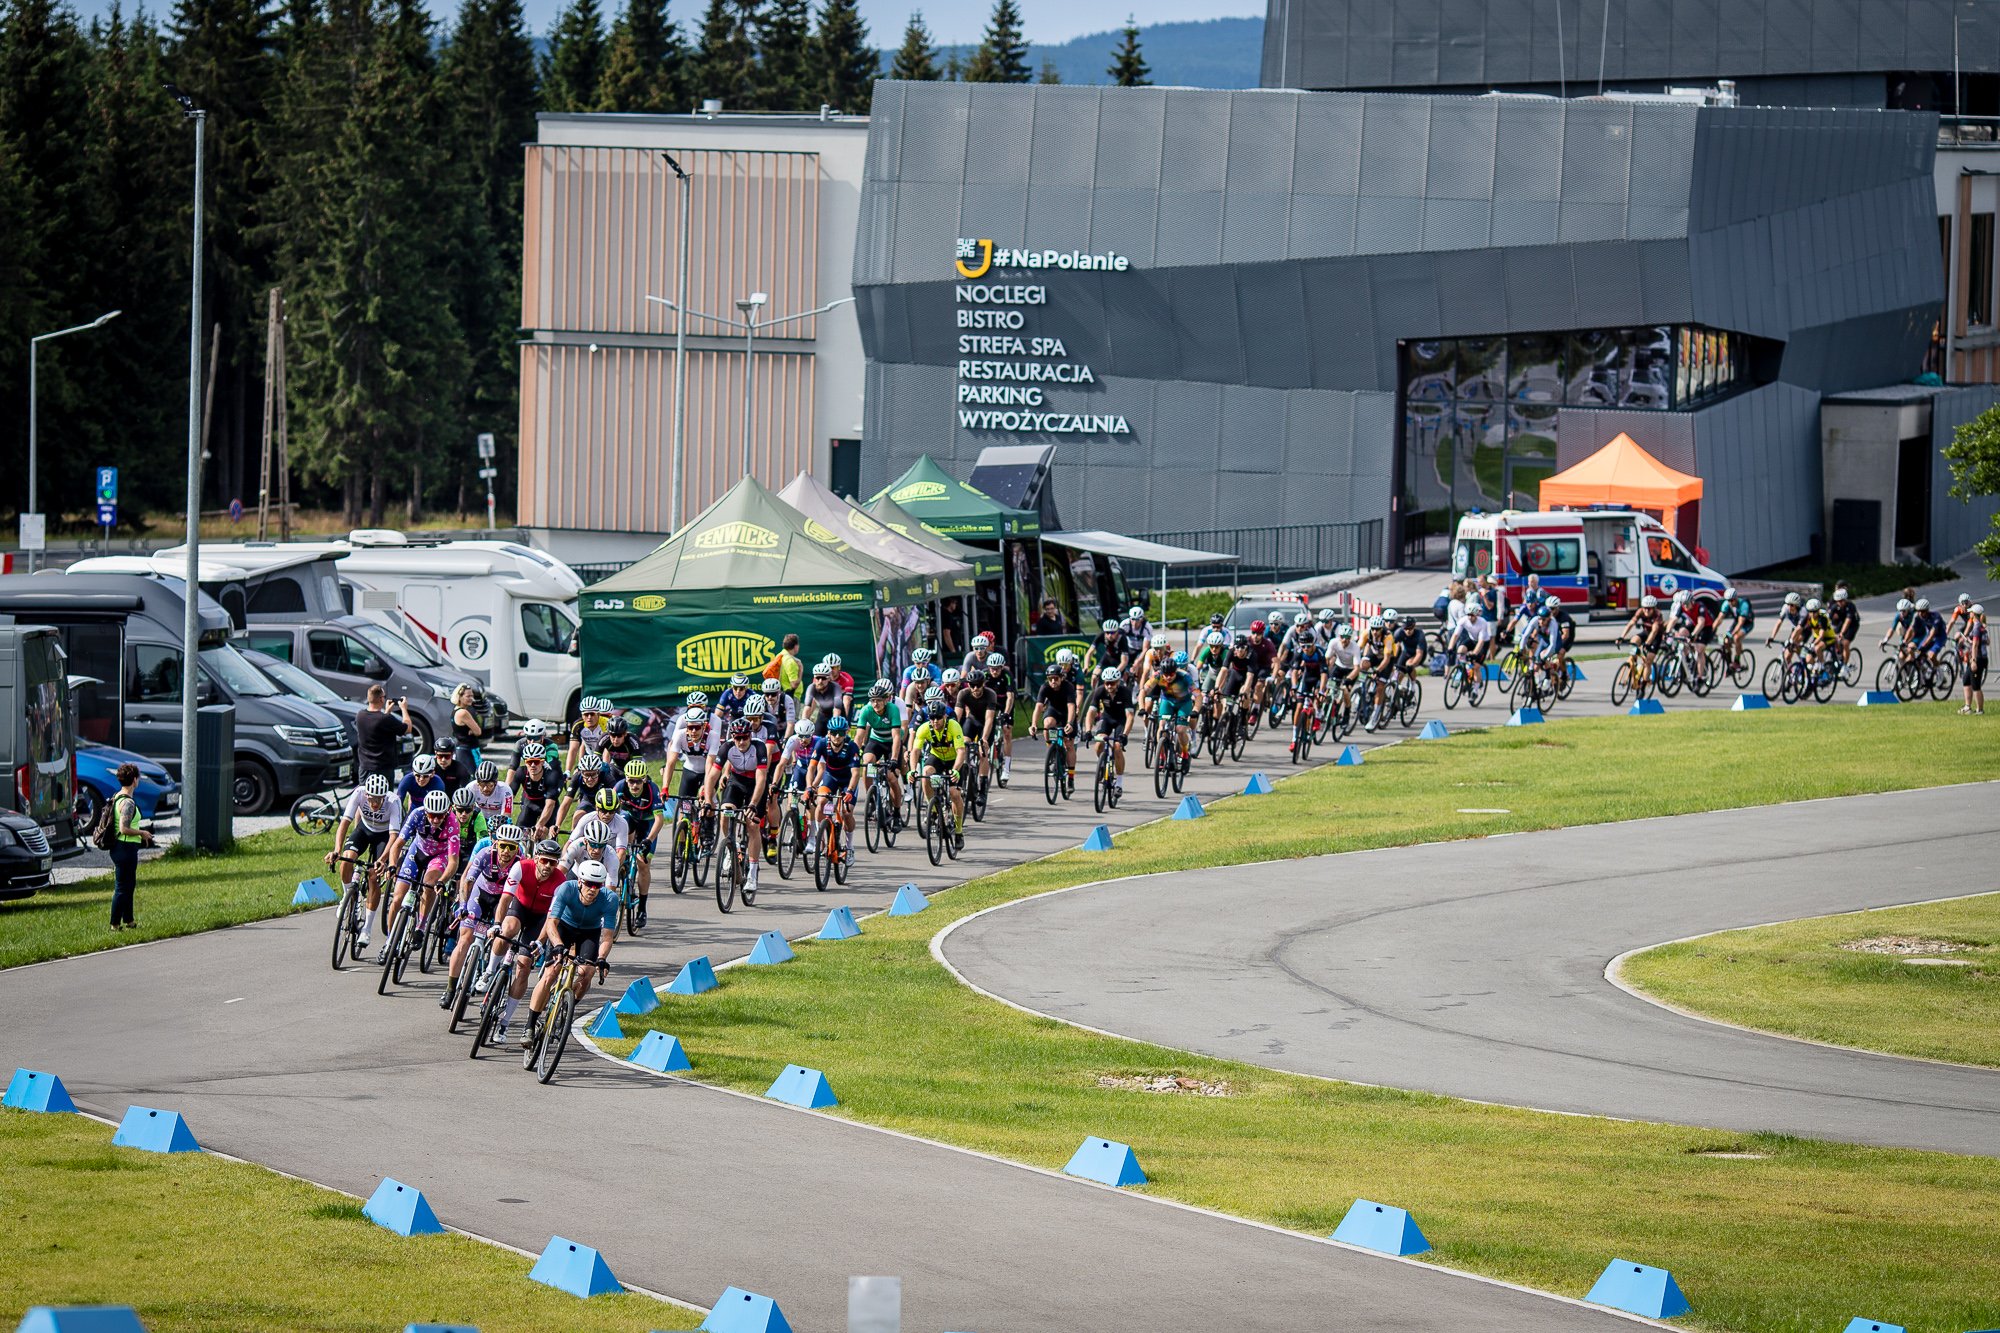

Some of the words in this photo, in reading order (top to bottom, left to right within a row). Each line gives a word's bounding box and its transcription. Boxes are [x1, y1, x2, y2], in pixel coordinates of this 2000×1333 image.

[993, 248, 1129, 271] #NaPolanie
[955, 285, 1046, 304] NOCLEGI
[957, 310, 1024, 330] BISTRO
[958, 335, 1025, 355] STREFA
[1031, 338, 1067, 357] SPA
[958, 360, 1094, 383] RESTAURACJA
[958, 385, 1043, 405] PARKING
[958, 408, 1130, 434] WYPOŻYCZALNIA
[753, 592, 863, 604] www.fenwicksbike.com
[676, 634, 776, 673] FENWICK'S
[678, 684, 725, 694] PREPARATY
